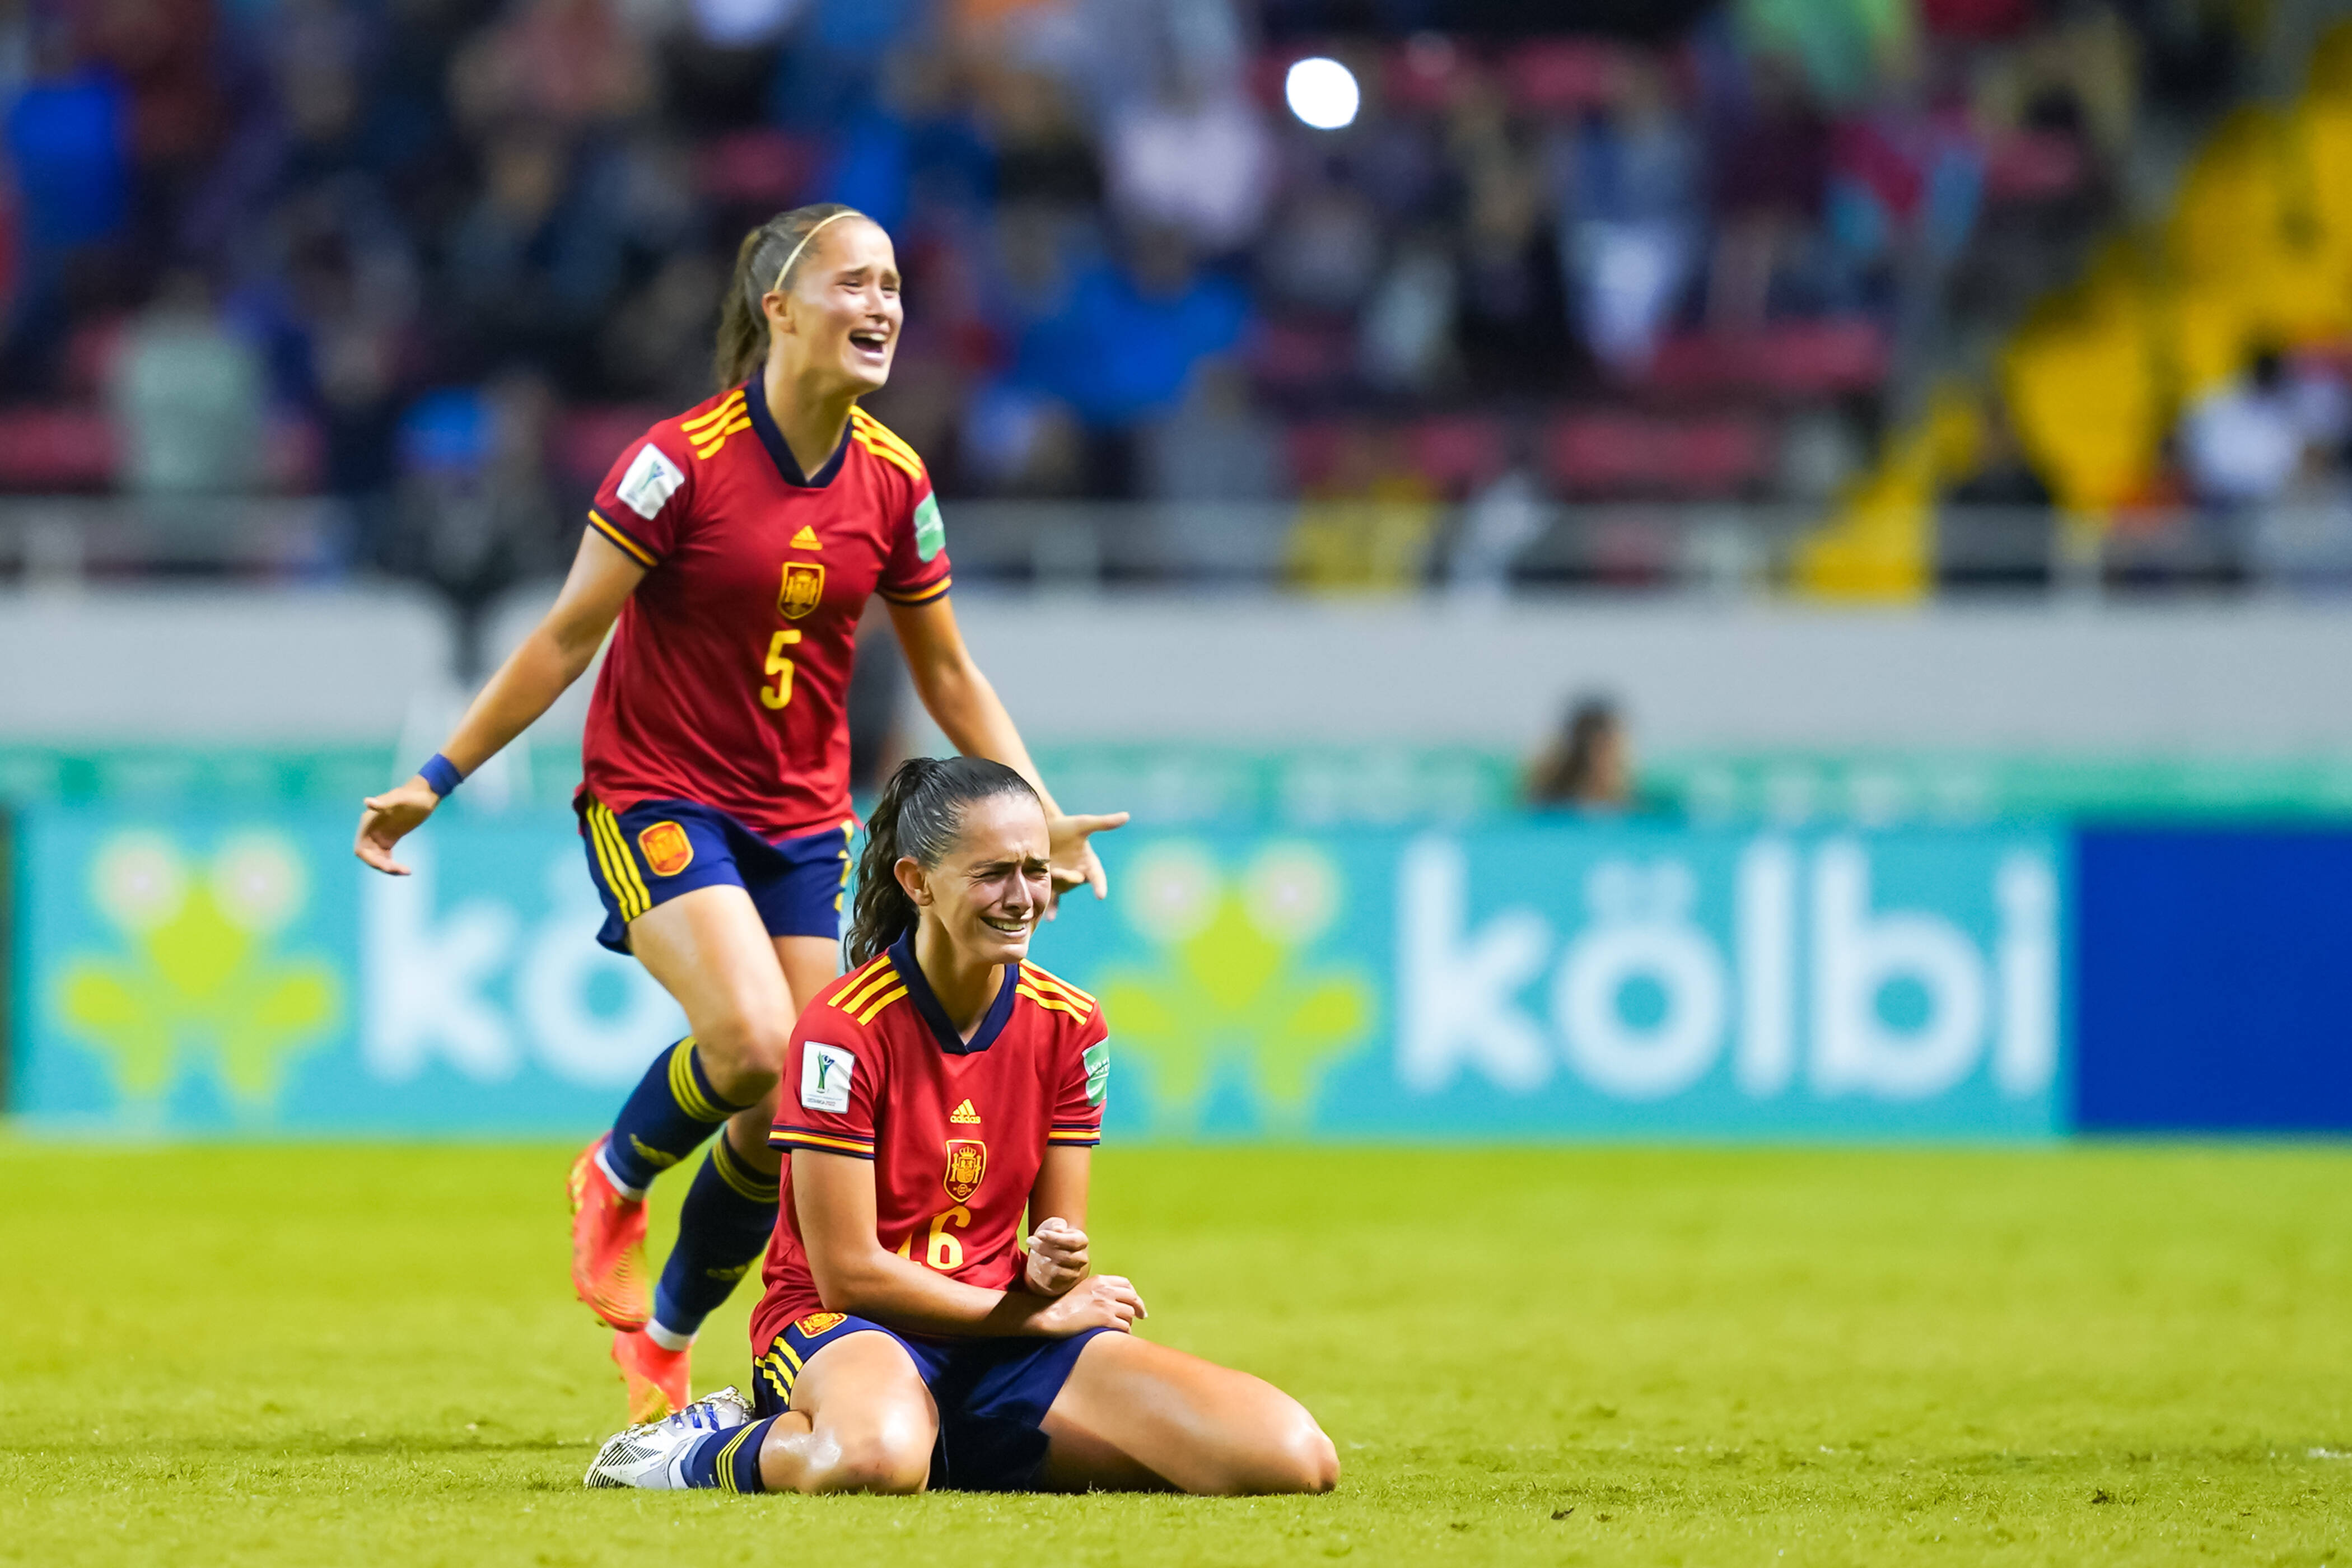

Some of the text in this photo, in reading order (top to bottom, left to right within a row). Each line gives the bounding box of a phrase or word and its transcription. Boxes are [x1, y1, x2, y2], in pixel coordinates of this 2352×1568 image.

[760, 629, 802, 710] 5
[363, 830, 690, 1089] kö
[1394, 836, 2059, 1096] kölbi
[950, 1115, 981, 1124] adidas
